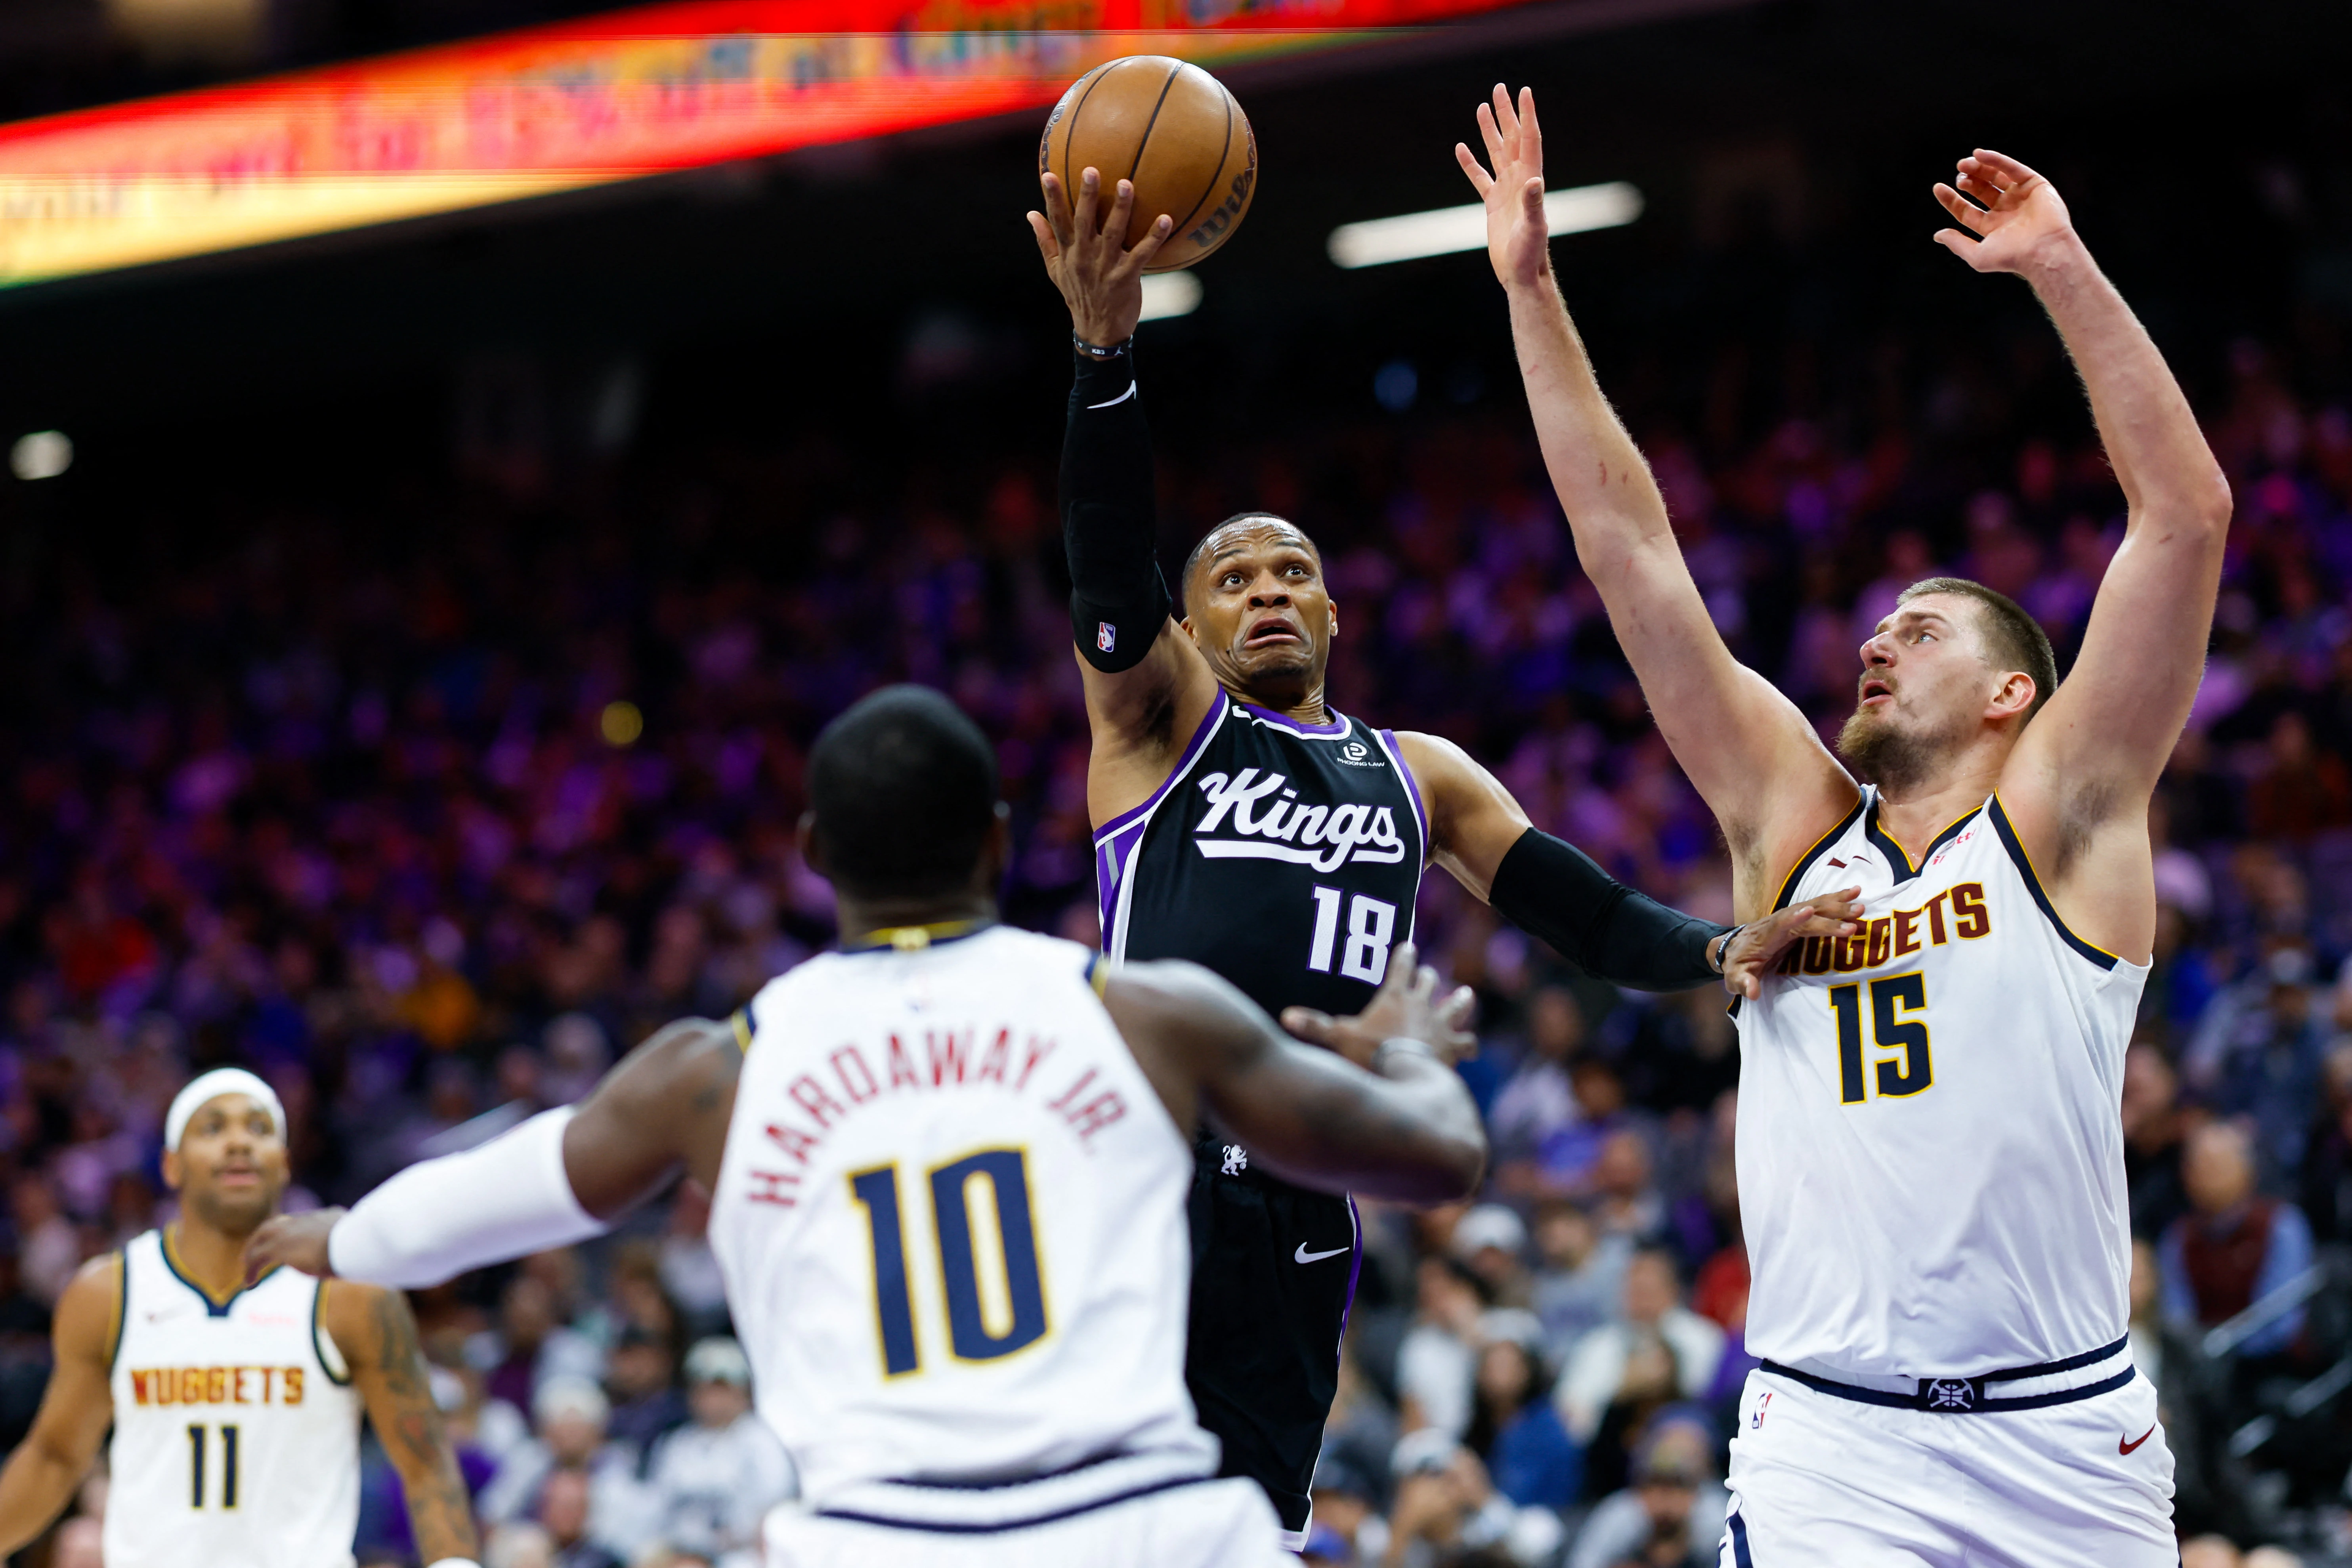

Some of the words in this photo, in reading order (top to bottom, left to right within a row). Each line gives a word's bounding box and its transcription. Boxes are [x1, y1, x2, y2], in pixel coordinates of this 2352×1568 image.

[1193, 768, 1405, 873] Kings
[1307, 882, 1399, 987] 18
[1827, 970, 1935, 1106] 15
[746, 1027, 1057, 1208] HARDAWAY
[845, 1142, 1055, 1381] 10
[130, 1366, 304, 1406] NUGGETS
[186, 1423, 241, 1511] 11
